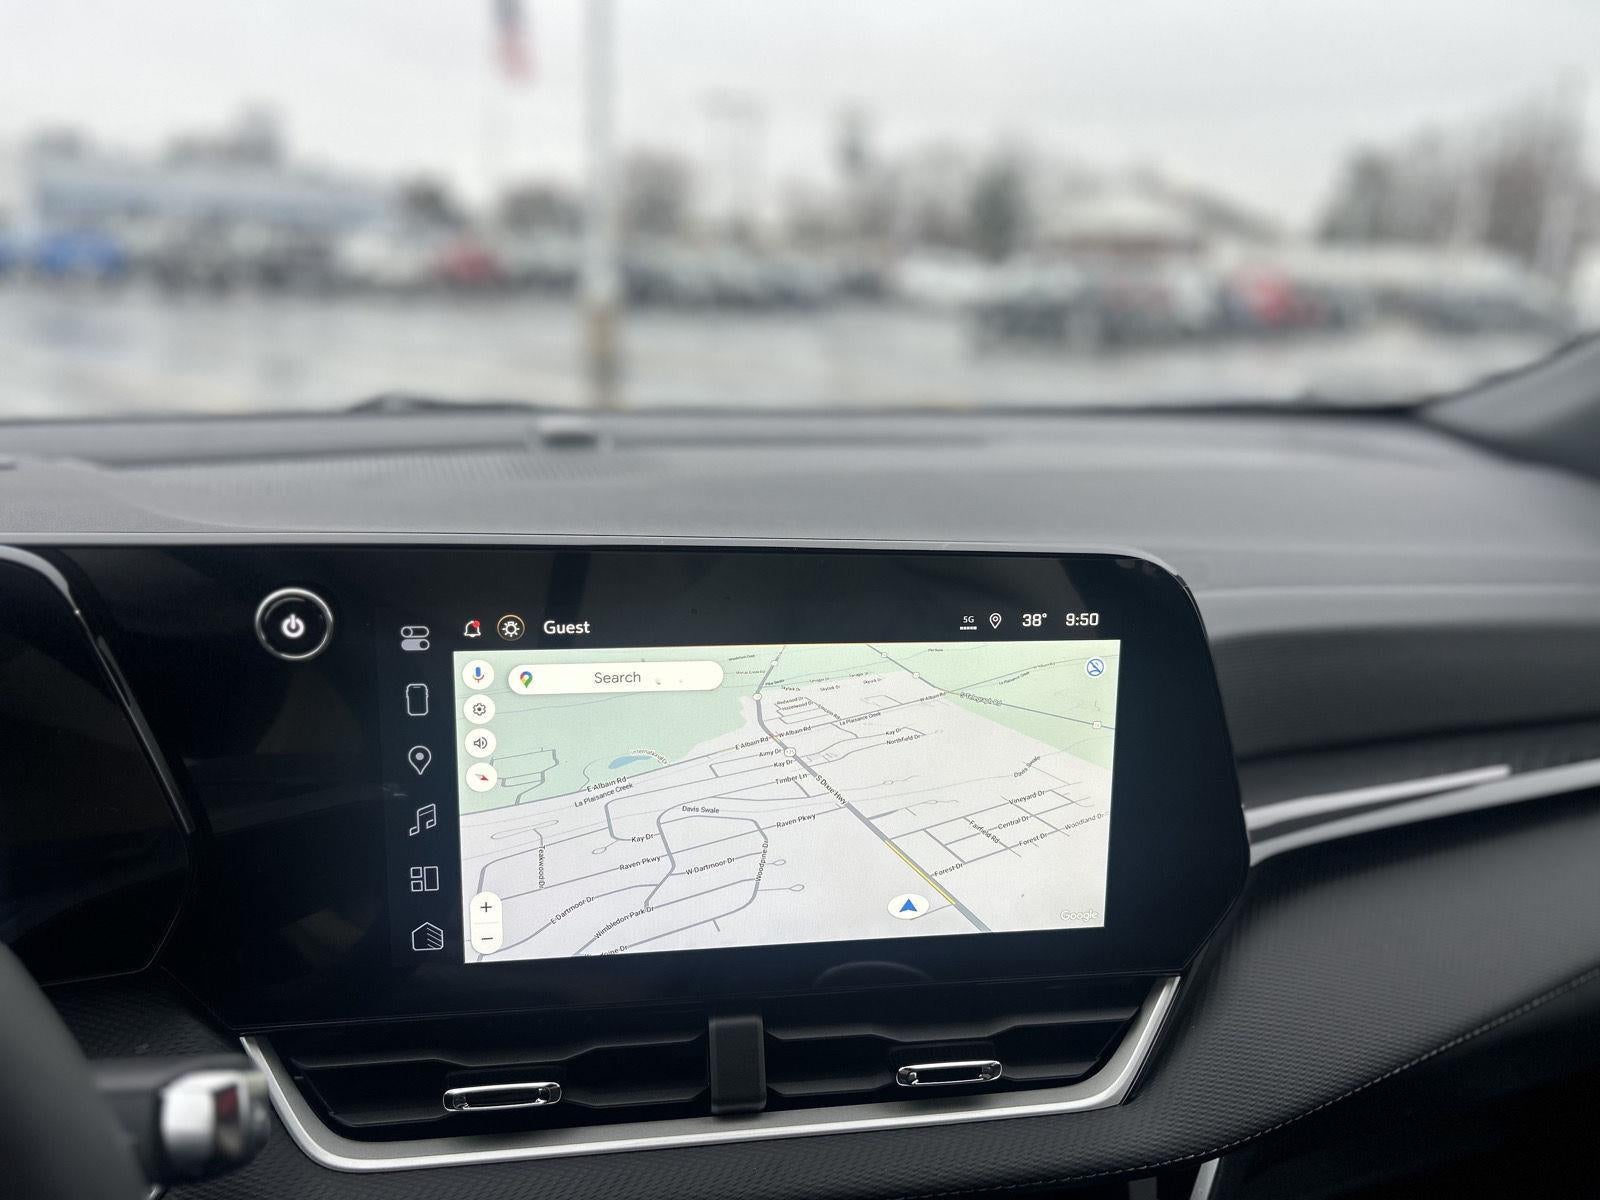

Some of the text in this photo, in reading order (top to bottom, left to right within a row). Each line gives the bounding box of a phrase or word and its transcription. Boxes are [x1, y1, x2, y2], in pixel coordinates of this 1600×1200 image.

[1022, 613, 1048, 627] 38°
[1065, 613, 1099, 626] 9:50
[544, 621, 590, 634] Guest
[594, 671, 641, 684] Search
[785, 728, 803, 736] Albain
[740, 740, 760, 748] Albain
[886, 735, 914, 745] Northfield
[1014, 756, 1041, 778] Davis Swale
[593, 780, 616, 790] Albain
[776, 775, 798, 785] Timber
[584, 790, 614, 805] Plaisance
[616, 782, 634, 793] Creek
[820, 778, 834, 794] Dixie
[833, 790, 846, 804] Hwy
[1009, 792, 1036, 805] Vineyard
[682, 805, 720, 814] Davis Swale
[776, 814, 816, 828] Raven Pkwy
[998, 818, 1021, 830] Central
[1064, 816, 1096, 830] Woodland
[970, 820, 1000, 844] Fairfield Rd
[1019, 835, 1040, 846] Forest
[538, 846, 546, 889] Teakwood Dr
[619, 856, 661, 870] Raven Pkwy
[694, 860, 726, 873] Dartmoor
[755, 840, 769, 882] Woodpine Dr
[934, 865, 954, 878] Forest
[556, 899, 586, 921] Dartmoor
[1060, 909, 1098, 922] Google
[594, 916, 630, 939] Wimbledon
[630, 908, 646, 919] Park
